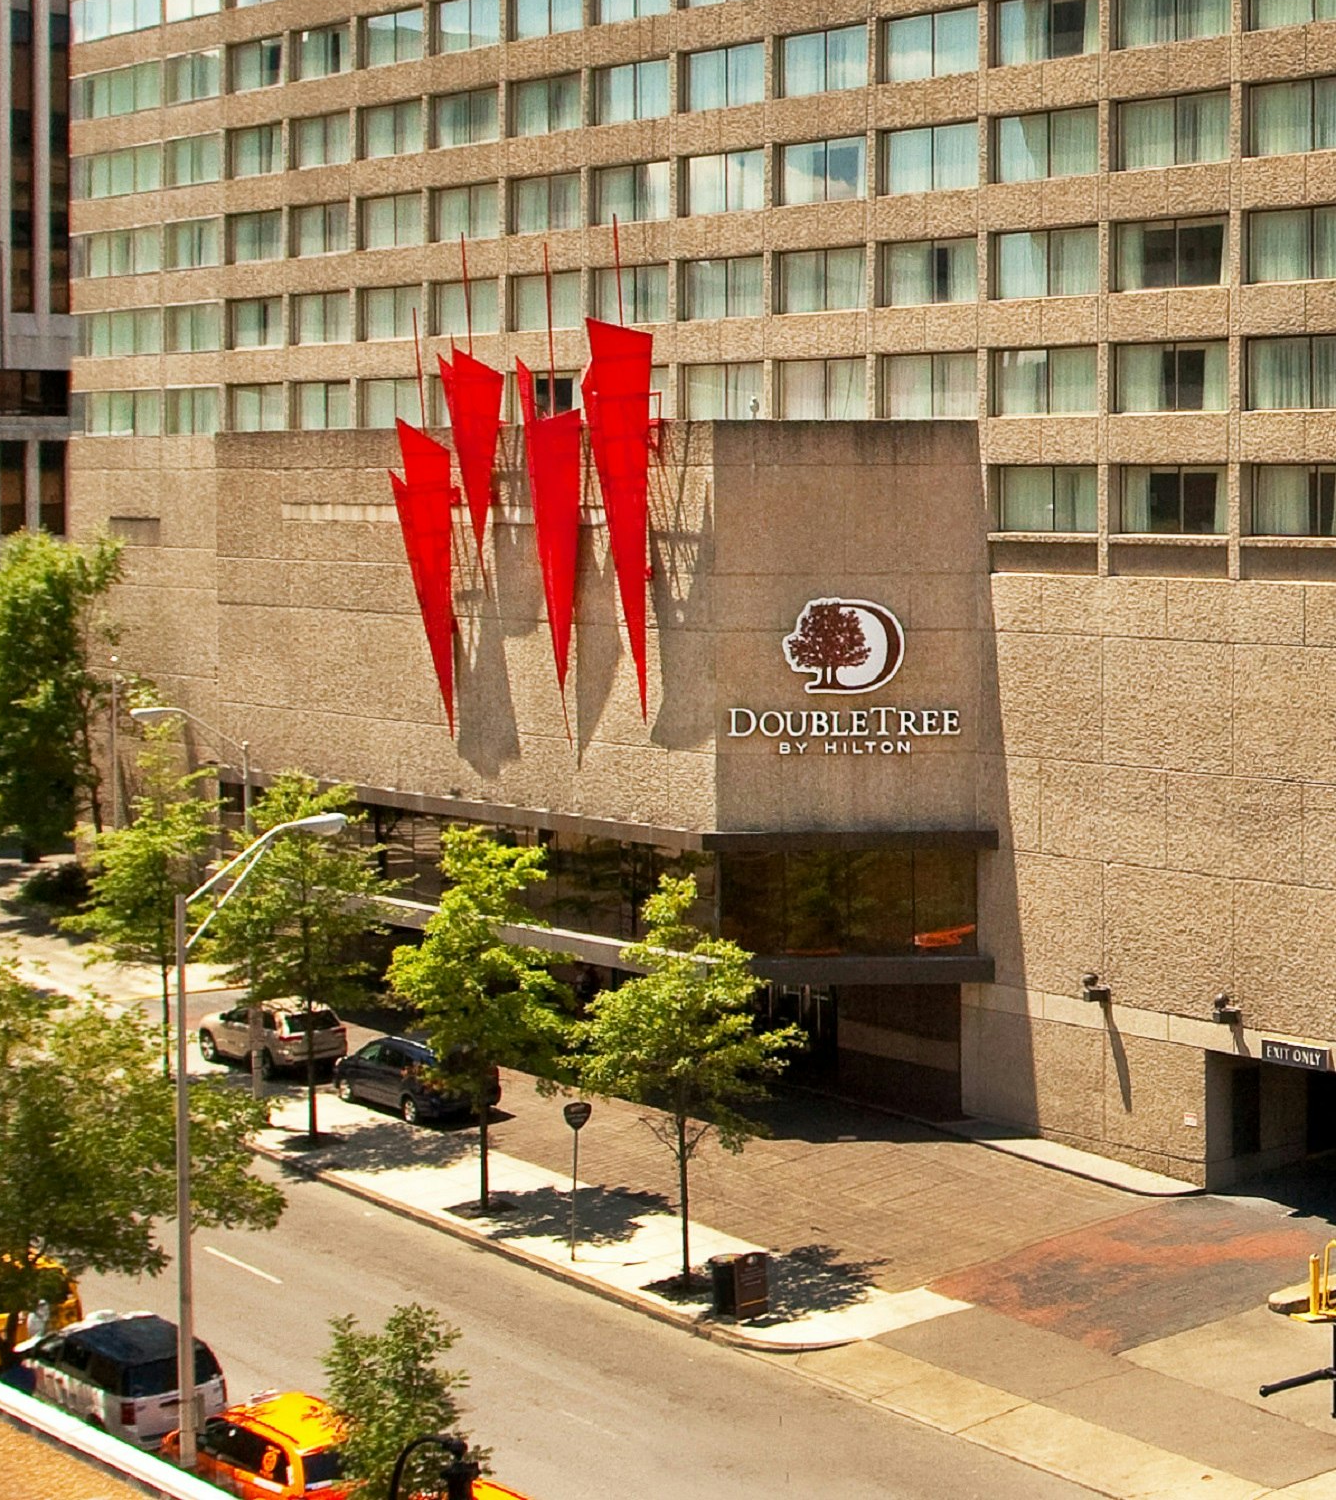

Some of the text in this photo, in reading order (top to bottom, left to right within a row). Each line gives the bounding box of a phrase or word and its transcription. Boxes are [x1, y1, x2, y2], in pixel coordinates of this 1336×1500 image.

[779, 740, 911, 754] BY HILTON
[1266, 1044, 1321, 1066] EXIT ONLY
